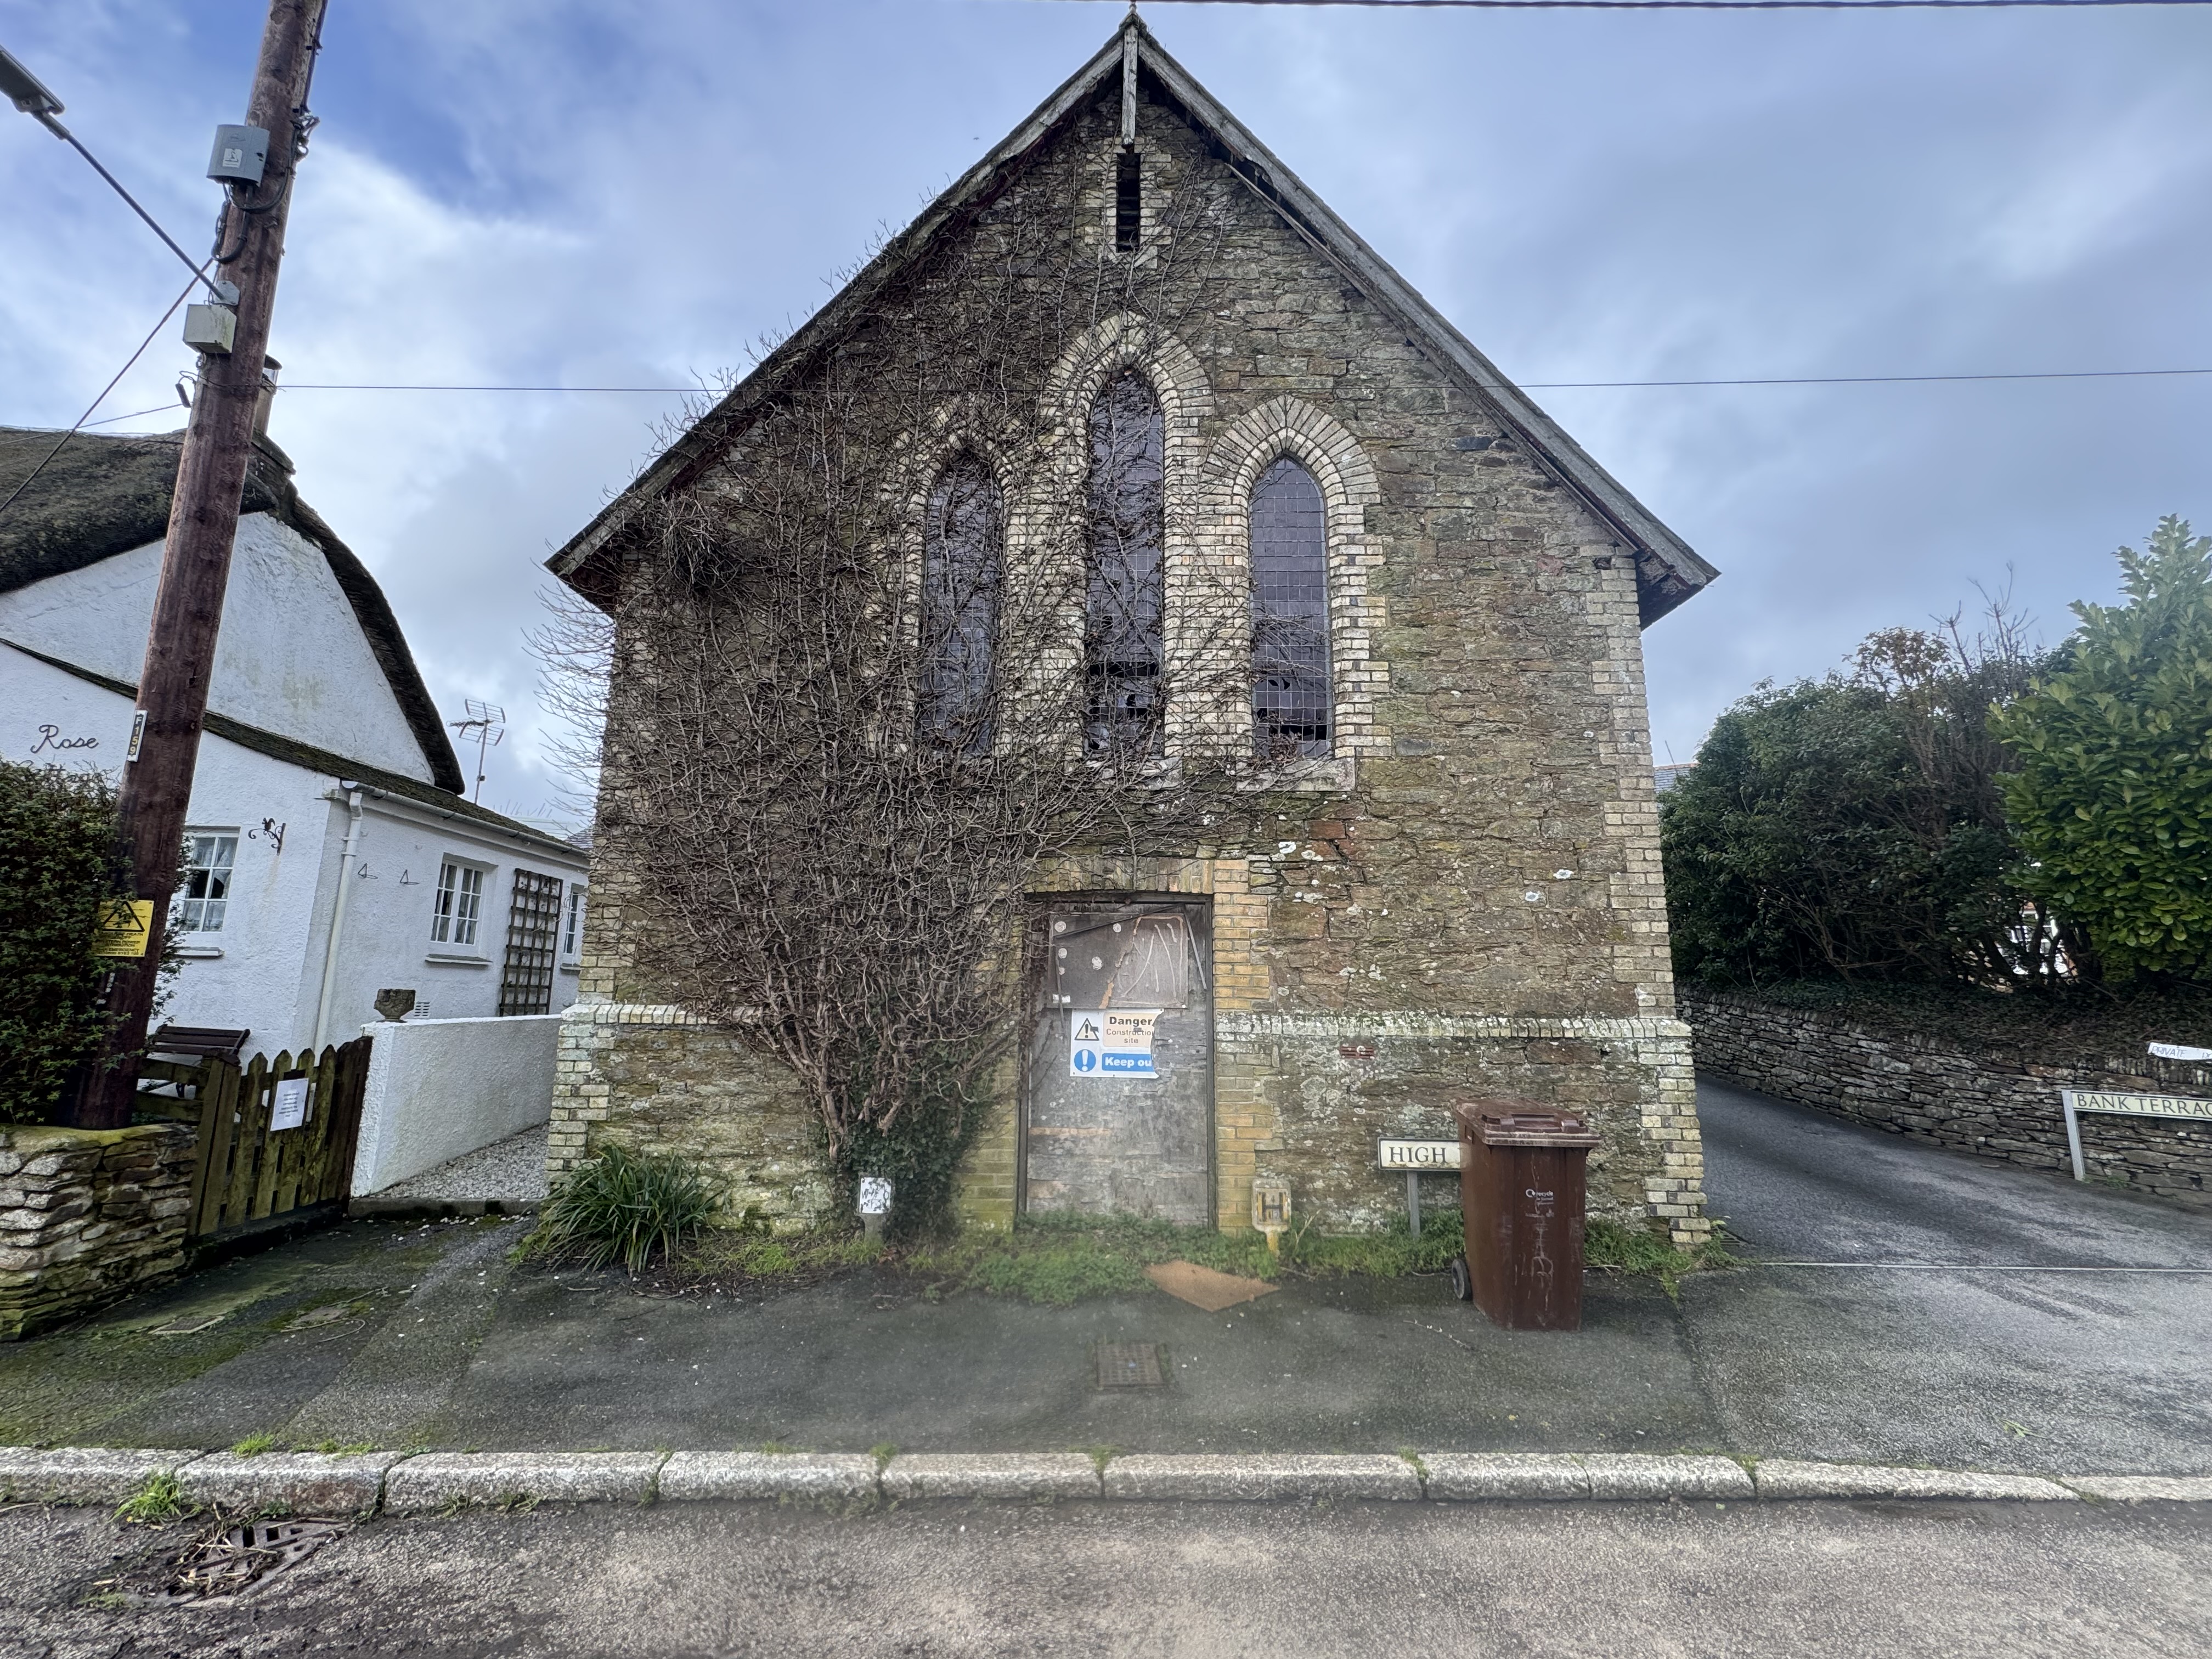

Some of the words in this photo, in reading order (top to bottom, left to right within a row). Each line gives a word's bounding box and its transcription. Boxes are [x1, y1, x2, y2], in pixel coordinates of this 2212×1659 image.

[30, 724, 99, 754] Rose
[130, 716, 143, 754] F159
[1109, 1017, 1153, 1027] Danger
[2152, 1046, 2186, 1058] PRIVATE
[1105, 1057, 1135, 1068] Keep
[2076, 1094, 2131, 1110] BANK
[2135, 1098, 2212, 1116] TERRAC
[1389, 1146, 1449, 1164] HIGH
